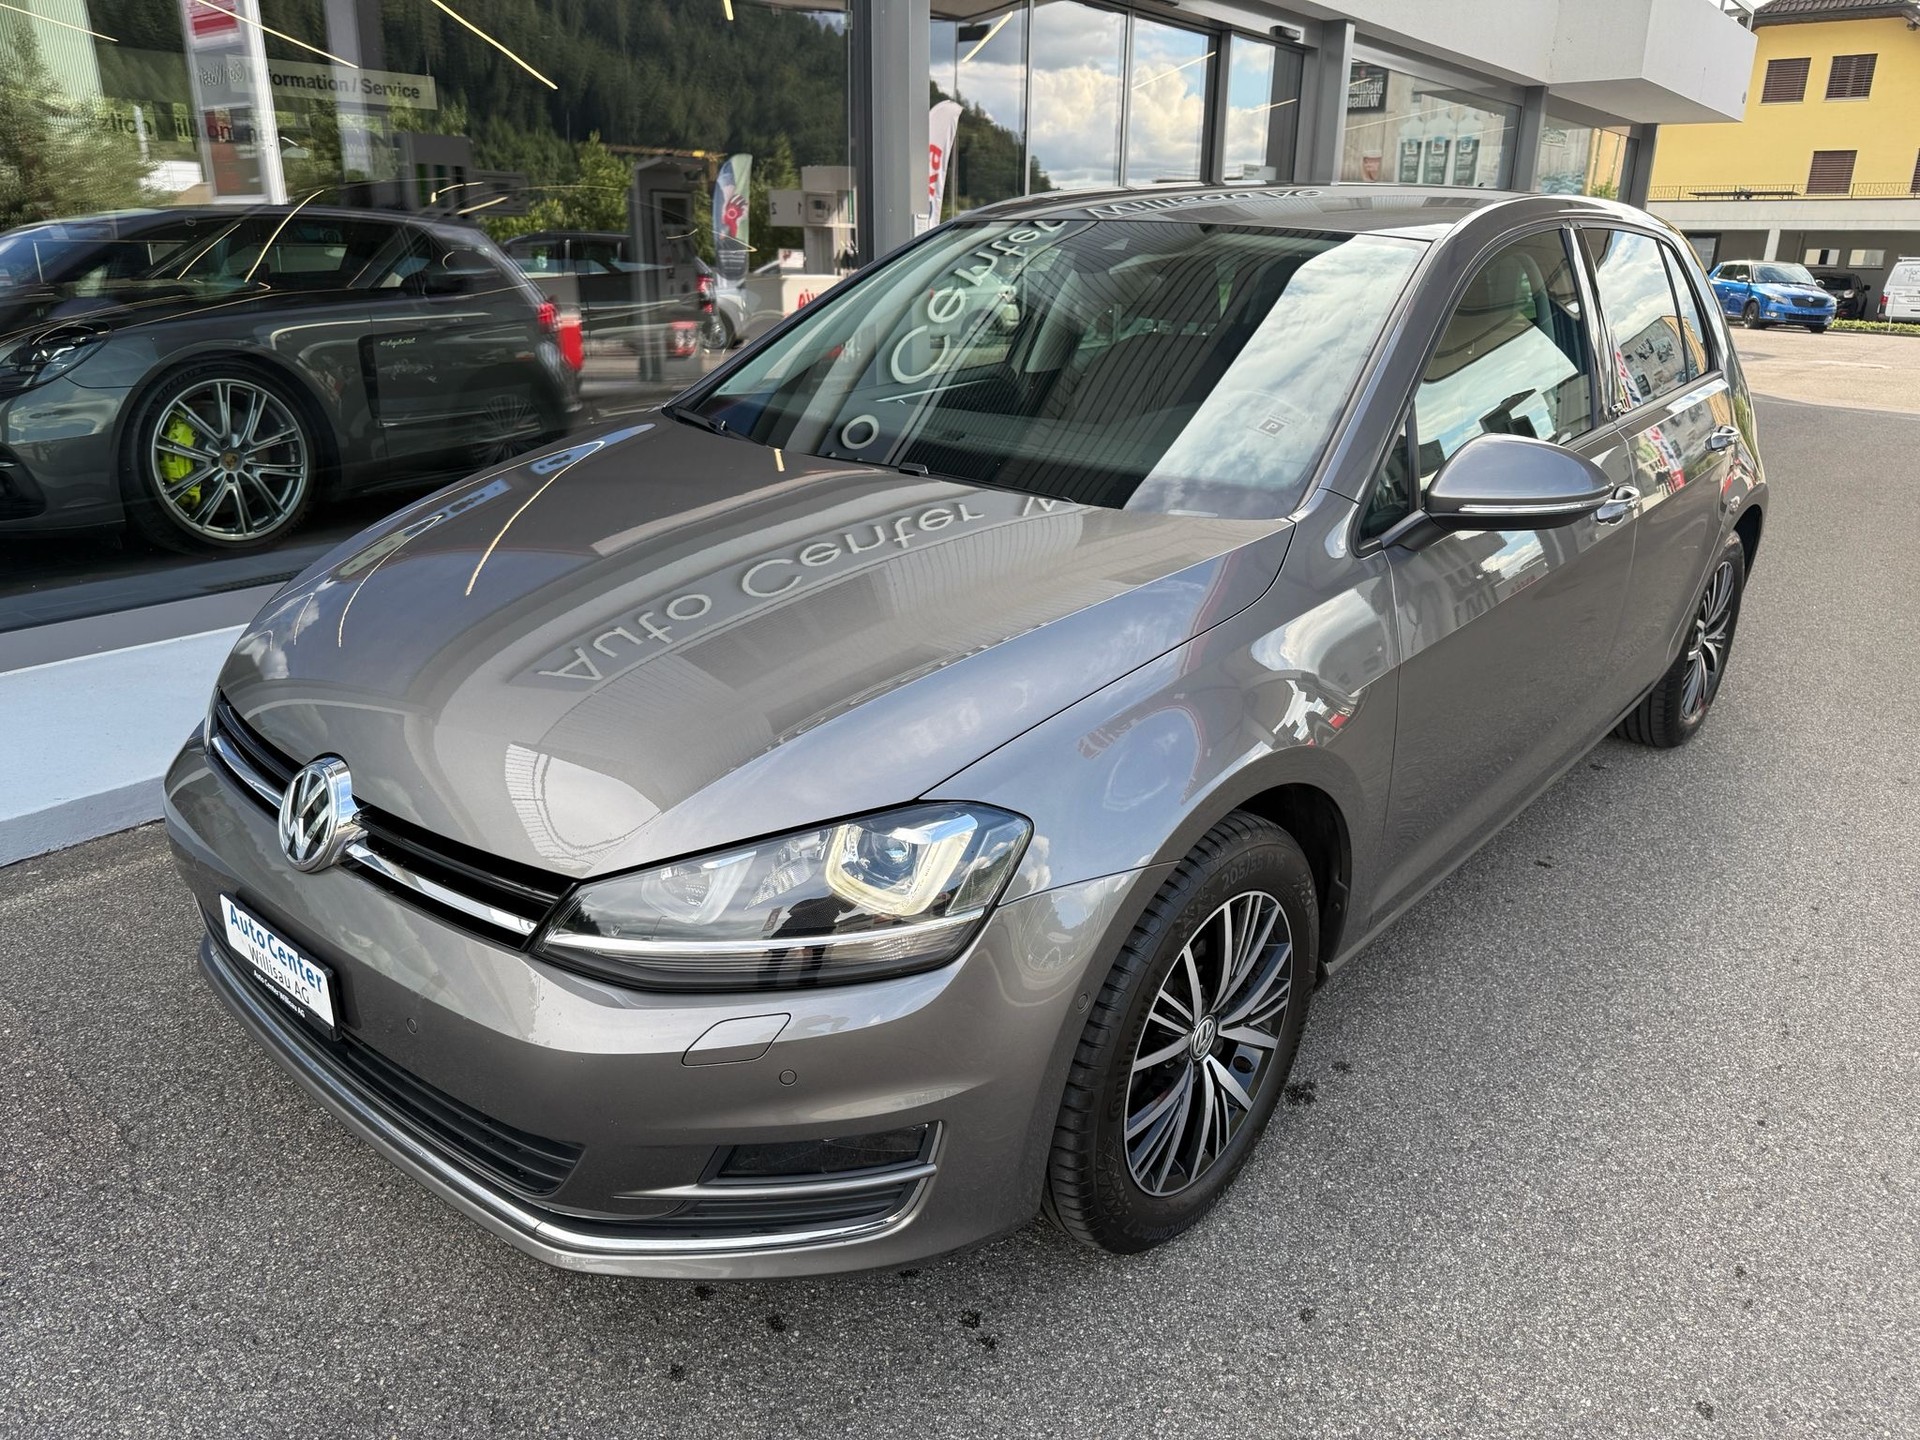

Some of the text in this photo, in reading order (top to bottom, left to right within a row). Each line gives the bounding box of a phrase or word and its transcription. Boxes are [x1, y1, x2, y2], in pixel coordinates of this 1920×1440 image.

[361, 78, 421, 99] Service
[248, 944, 310, 1004] Willisau AG
